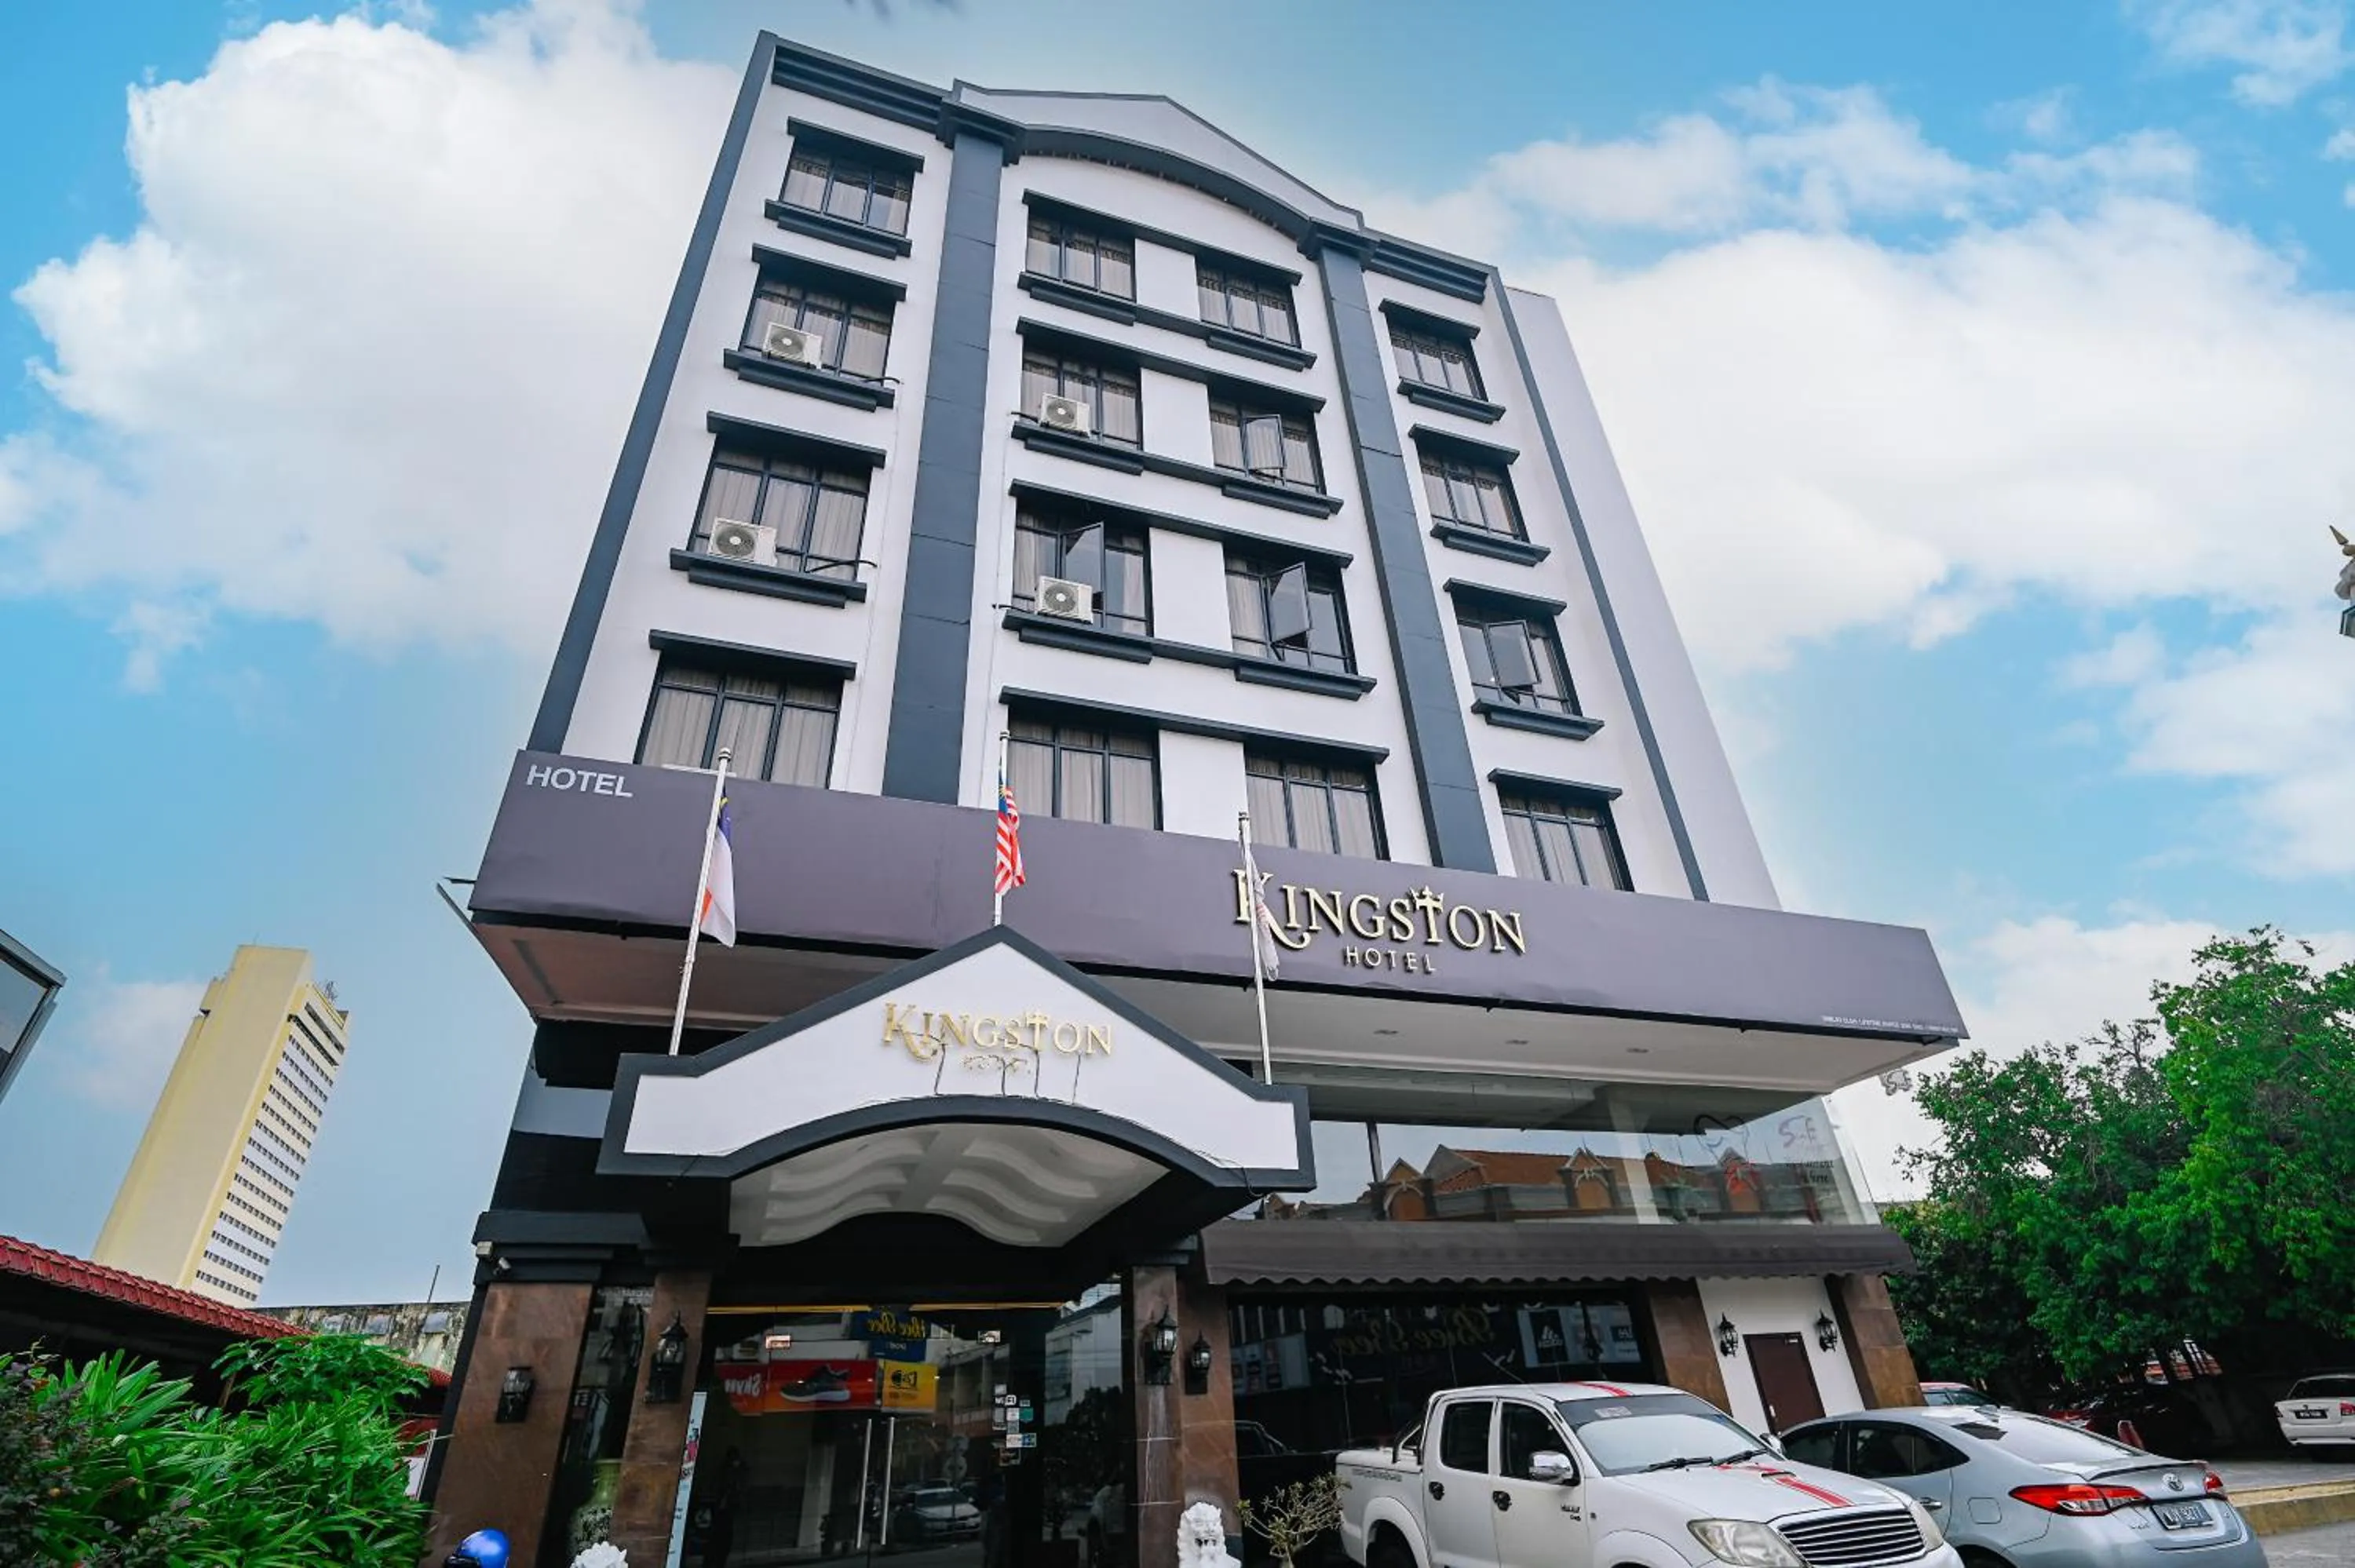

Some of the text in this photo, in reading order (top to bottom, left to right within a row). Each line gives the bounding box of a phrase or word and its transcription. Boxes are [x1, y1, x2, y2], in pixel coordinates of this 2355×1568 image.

[526, 764, 633, 798] HOTEL
[1344, 945, 1437, 972] HOTEL
[882, 1001, 1112, 1063] KINGSTON
